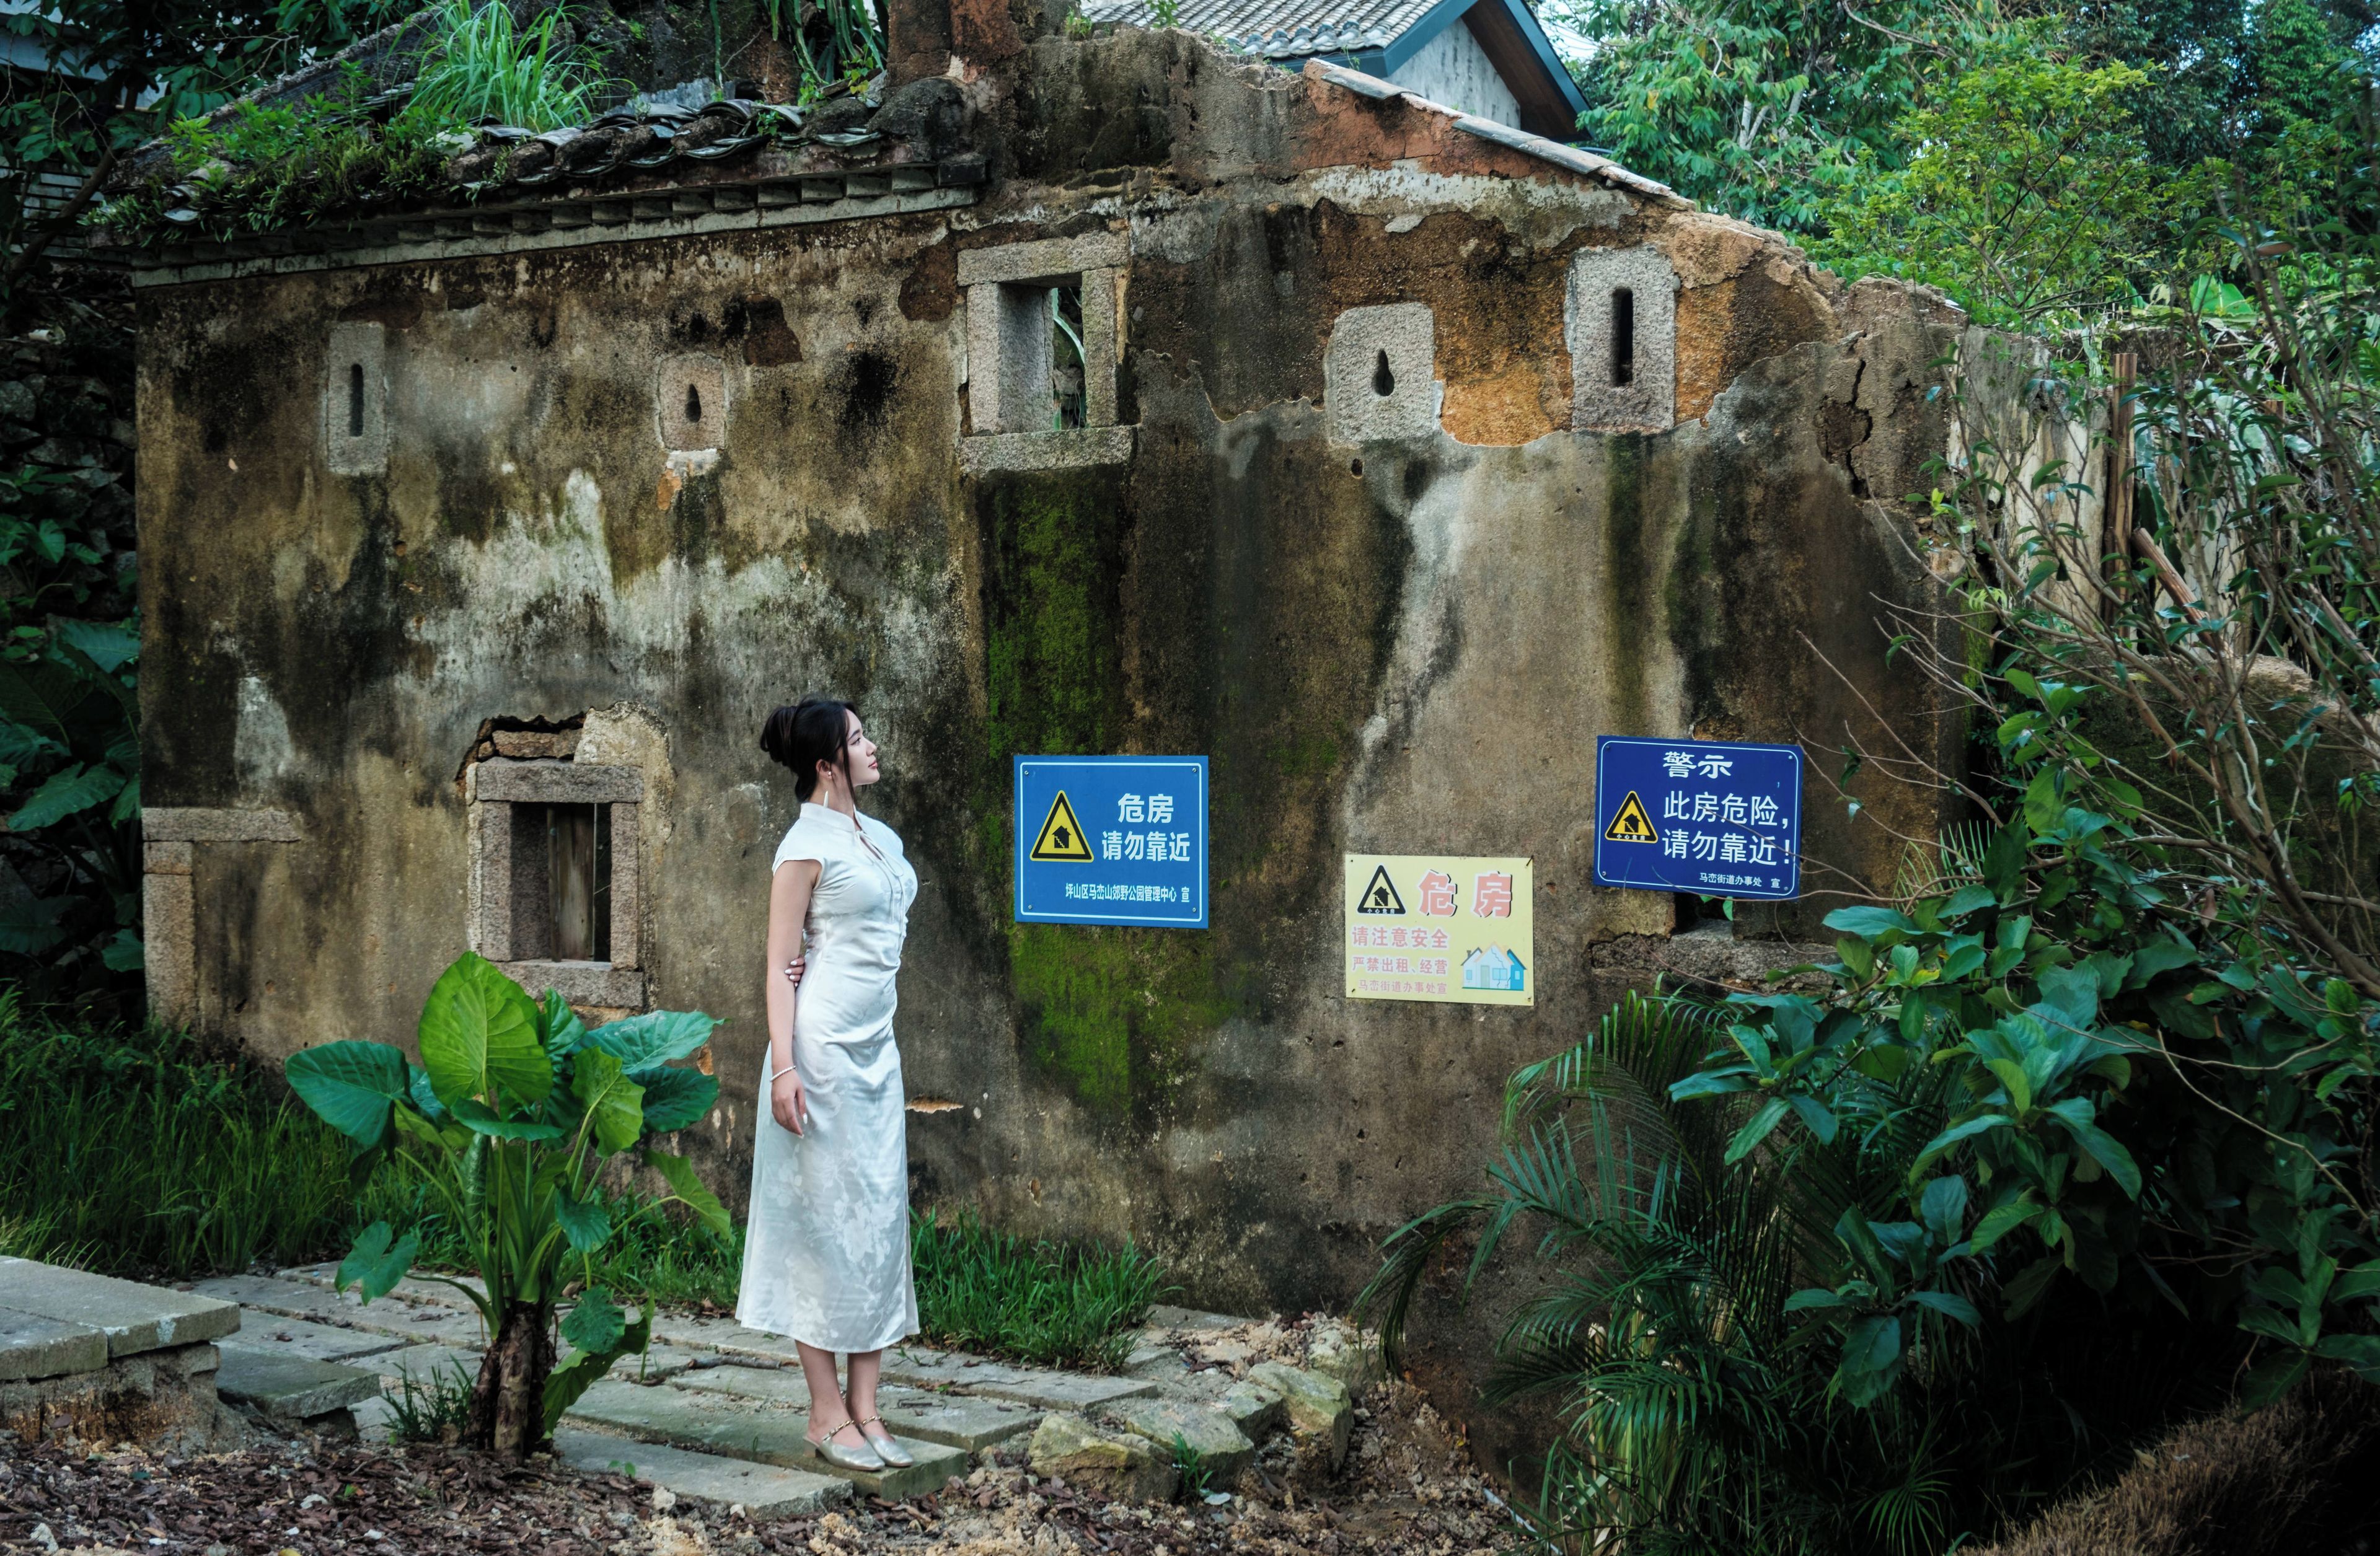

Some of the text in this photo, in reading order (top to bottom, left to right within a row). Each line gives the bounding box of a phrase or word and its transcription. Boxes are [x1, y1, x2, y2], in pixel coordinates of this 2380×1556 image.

[1662, 751, 1734, 779] 警示
[1117, 793, 1174, 824] 危房
[1101, 830, 1190, 861] 请勿靠近
[1065, 882, 1190, 903] 坪山区马峦山郊野公园管理中心 宣
[1699, 873, 1781, 889] 马峦街道办事处 宣
[1418, 869, 1512, 918] 危房
[1352, 926, 1448, 949] 请注意安全
[1352, 956, 1448, 975] 严禁出租、经营
[1359, 979, 1447, 995] 马峦街道办事处宣
